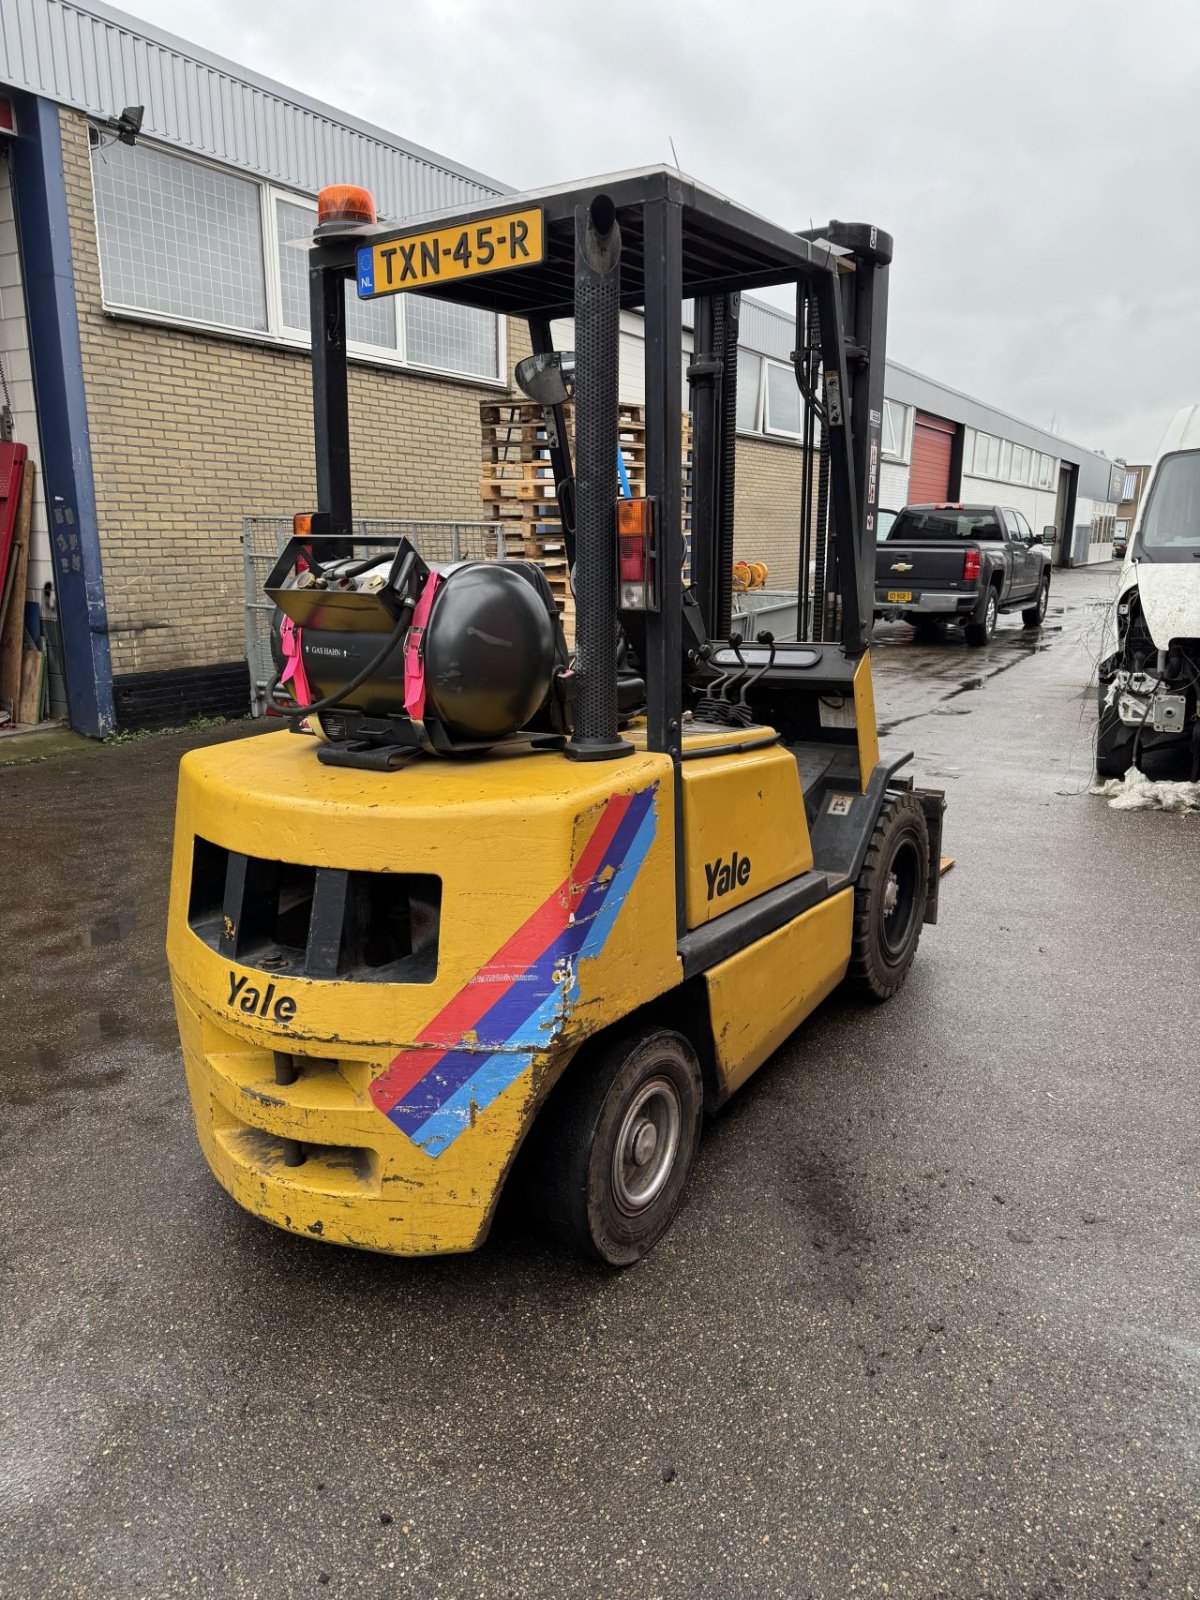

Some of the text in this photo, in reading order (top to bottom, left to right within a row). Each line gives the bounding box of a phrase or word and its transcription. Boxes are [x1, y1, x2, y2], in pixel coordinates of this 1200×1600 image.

[380, 220, 530, 284] TXN-45-R
[361, 277, 373, 288] NL
[311, 646, 341, 656] GAS HAHN
[704, 851, 751, 901] Yale
[227, 970, 297, 1023] Yale
